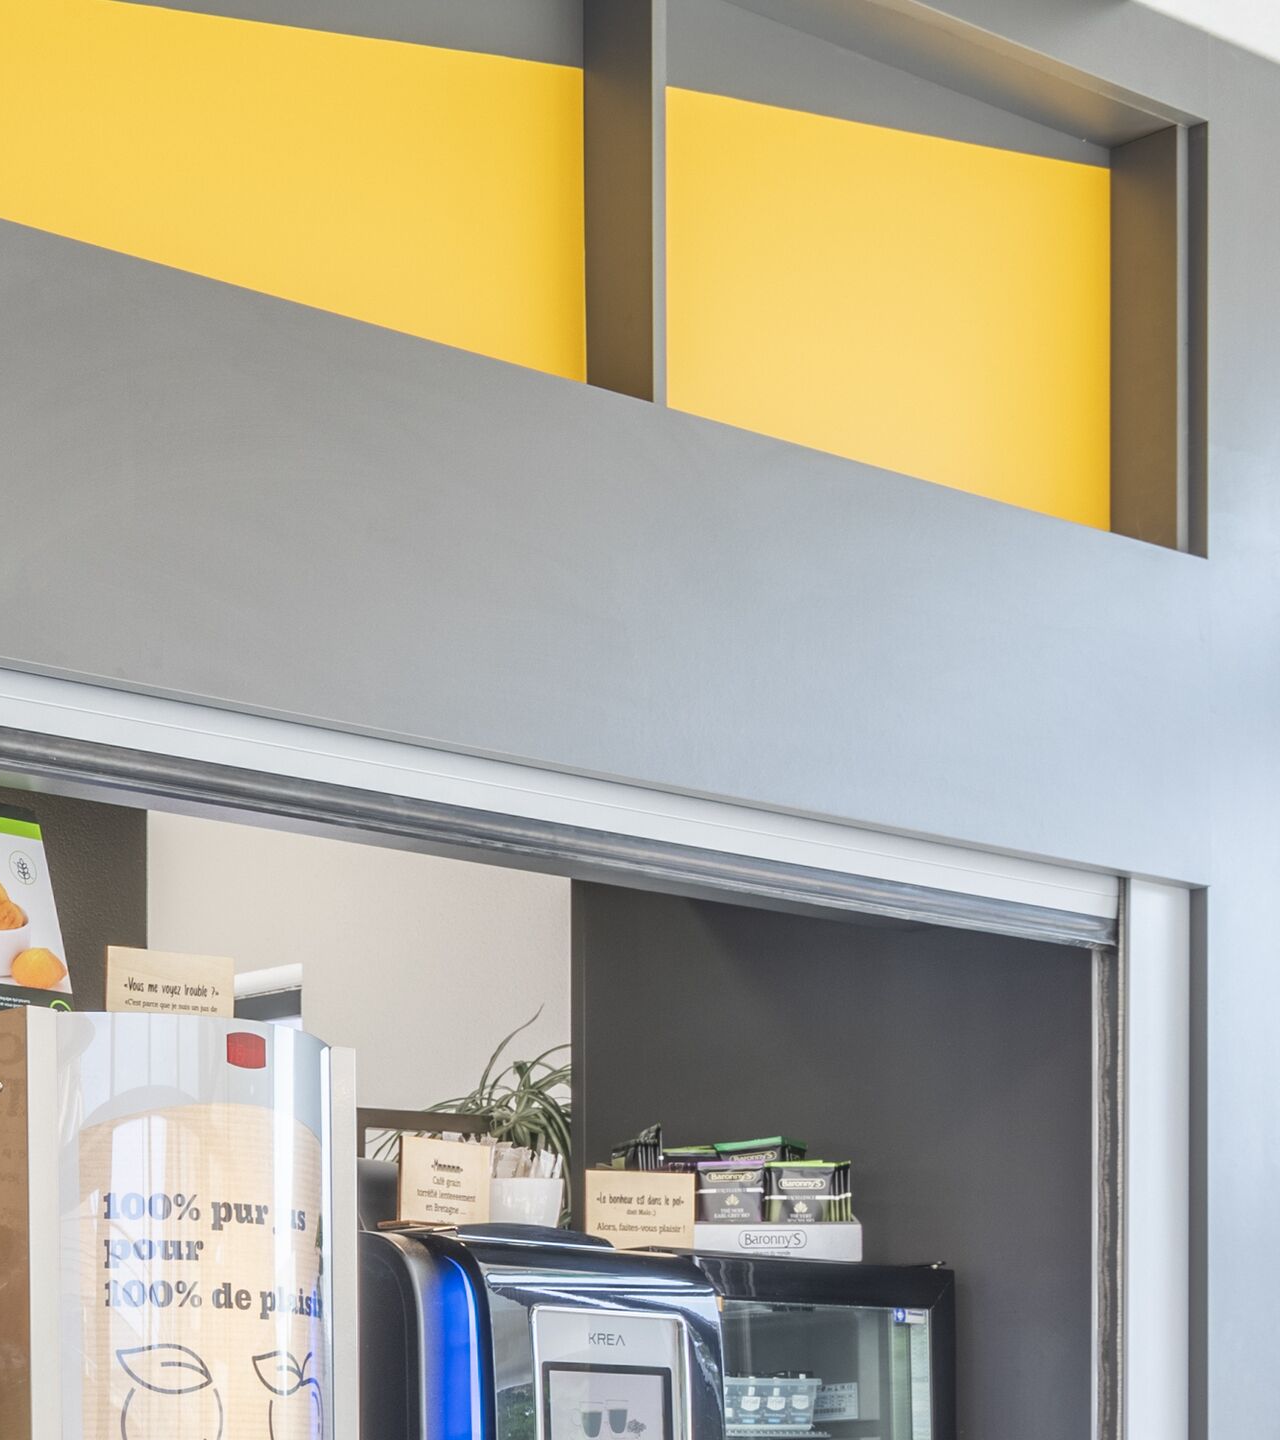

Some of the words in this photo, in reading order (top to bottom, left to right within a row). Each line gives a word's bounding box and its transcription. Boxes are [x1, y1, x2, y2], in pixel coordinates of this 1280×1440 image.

[148, 983, 158, 993] me
[162, 984, 181, 998] voyez
[103, 1192, 200, 1222] 100%
[211, 1200, 268, 1231] pur
[658, 1224, 680, 1234] plaisir
[104, 1238, 204, 1268] pour
[104, 1280, 202, 1308] 100%
[211, 1282, 252, 1309] de
[588, 1332, 626, 1346] KREA
